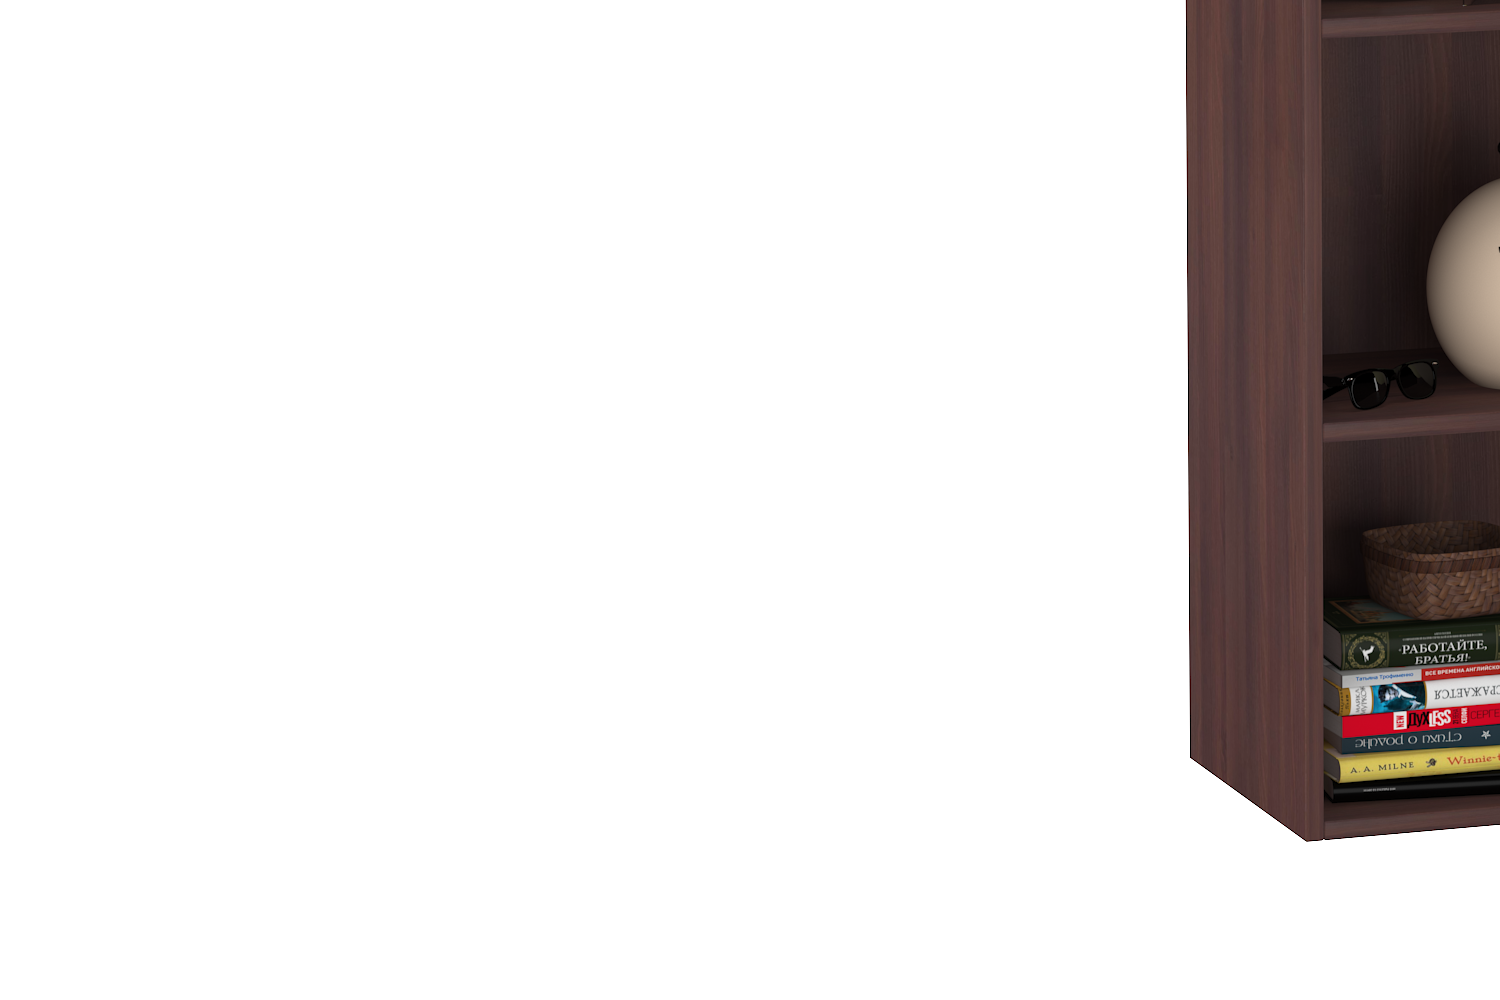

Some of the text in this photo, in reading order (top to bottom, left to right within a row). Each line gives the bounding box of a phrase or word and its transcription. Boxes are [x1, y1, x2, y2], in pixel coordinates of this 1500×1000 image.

[1437, 667, 1465, 675] ВРЕМЕНА
[1356, 671, 1414, 682] Татьяна Трофименко
[1396, 715, 1405, 729] NEW
[1378, 761, 1415, 771] MILNE
